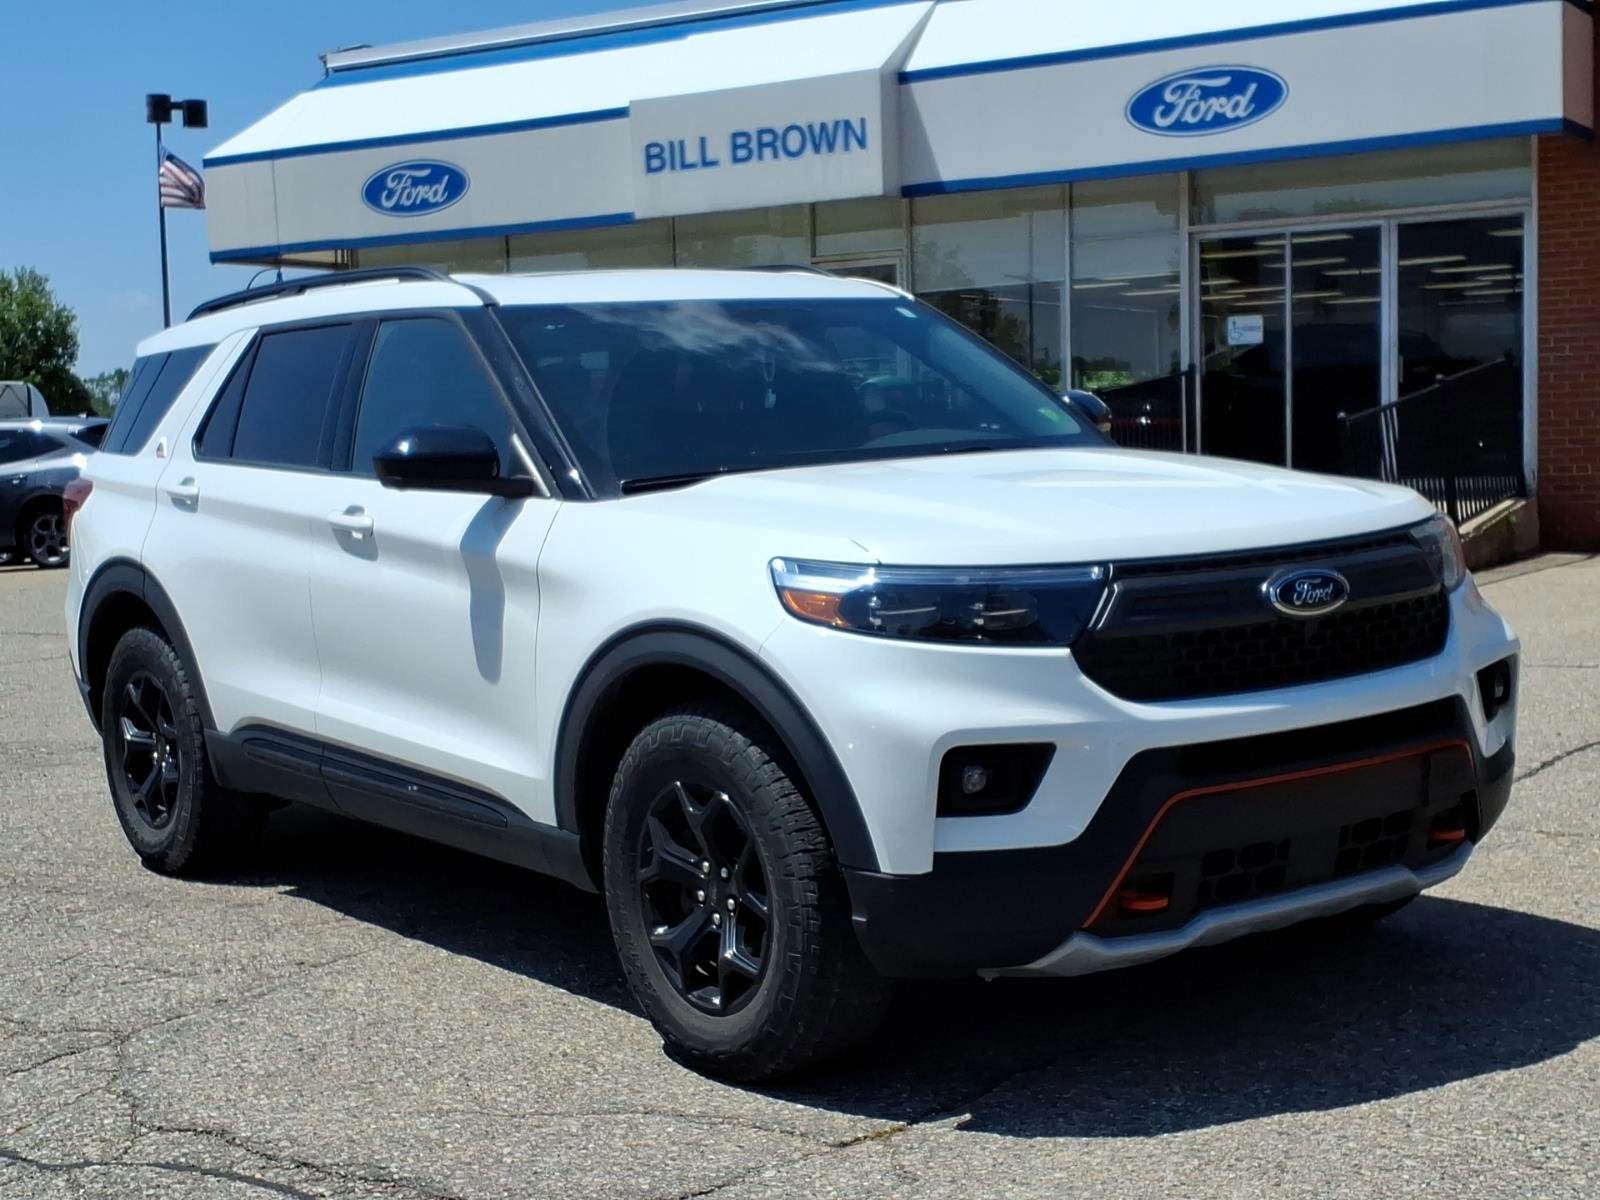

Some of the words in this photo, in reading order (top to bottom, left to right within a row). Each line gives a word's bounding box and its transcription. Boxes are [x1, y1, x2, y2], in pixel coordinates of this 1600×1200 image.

[1153, 75, 1258, 128] Ford
[644, 136, 720, 175] BILL
[730, 117, 867, 165] BROWN
[381, 168, 449, 209] Ford
[1293, 577, 1334, 606] Ford
